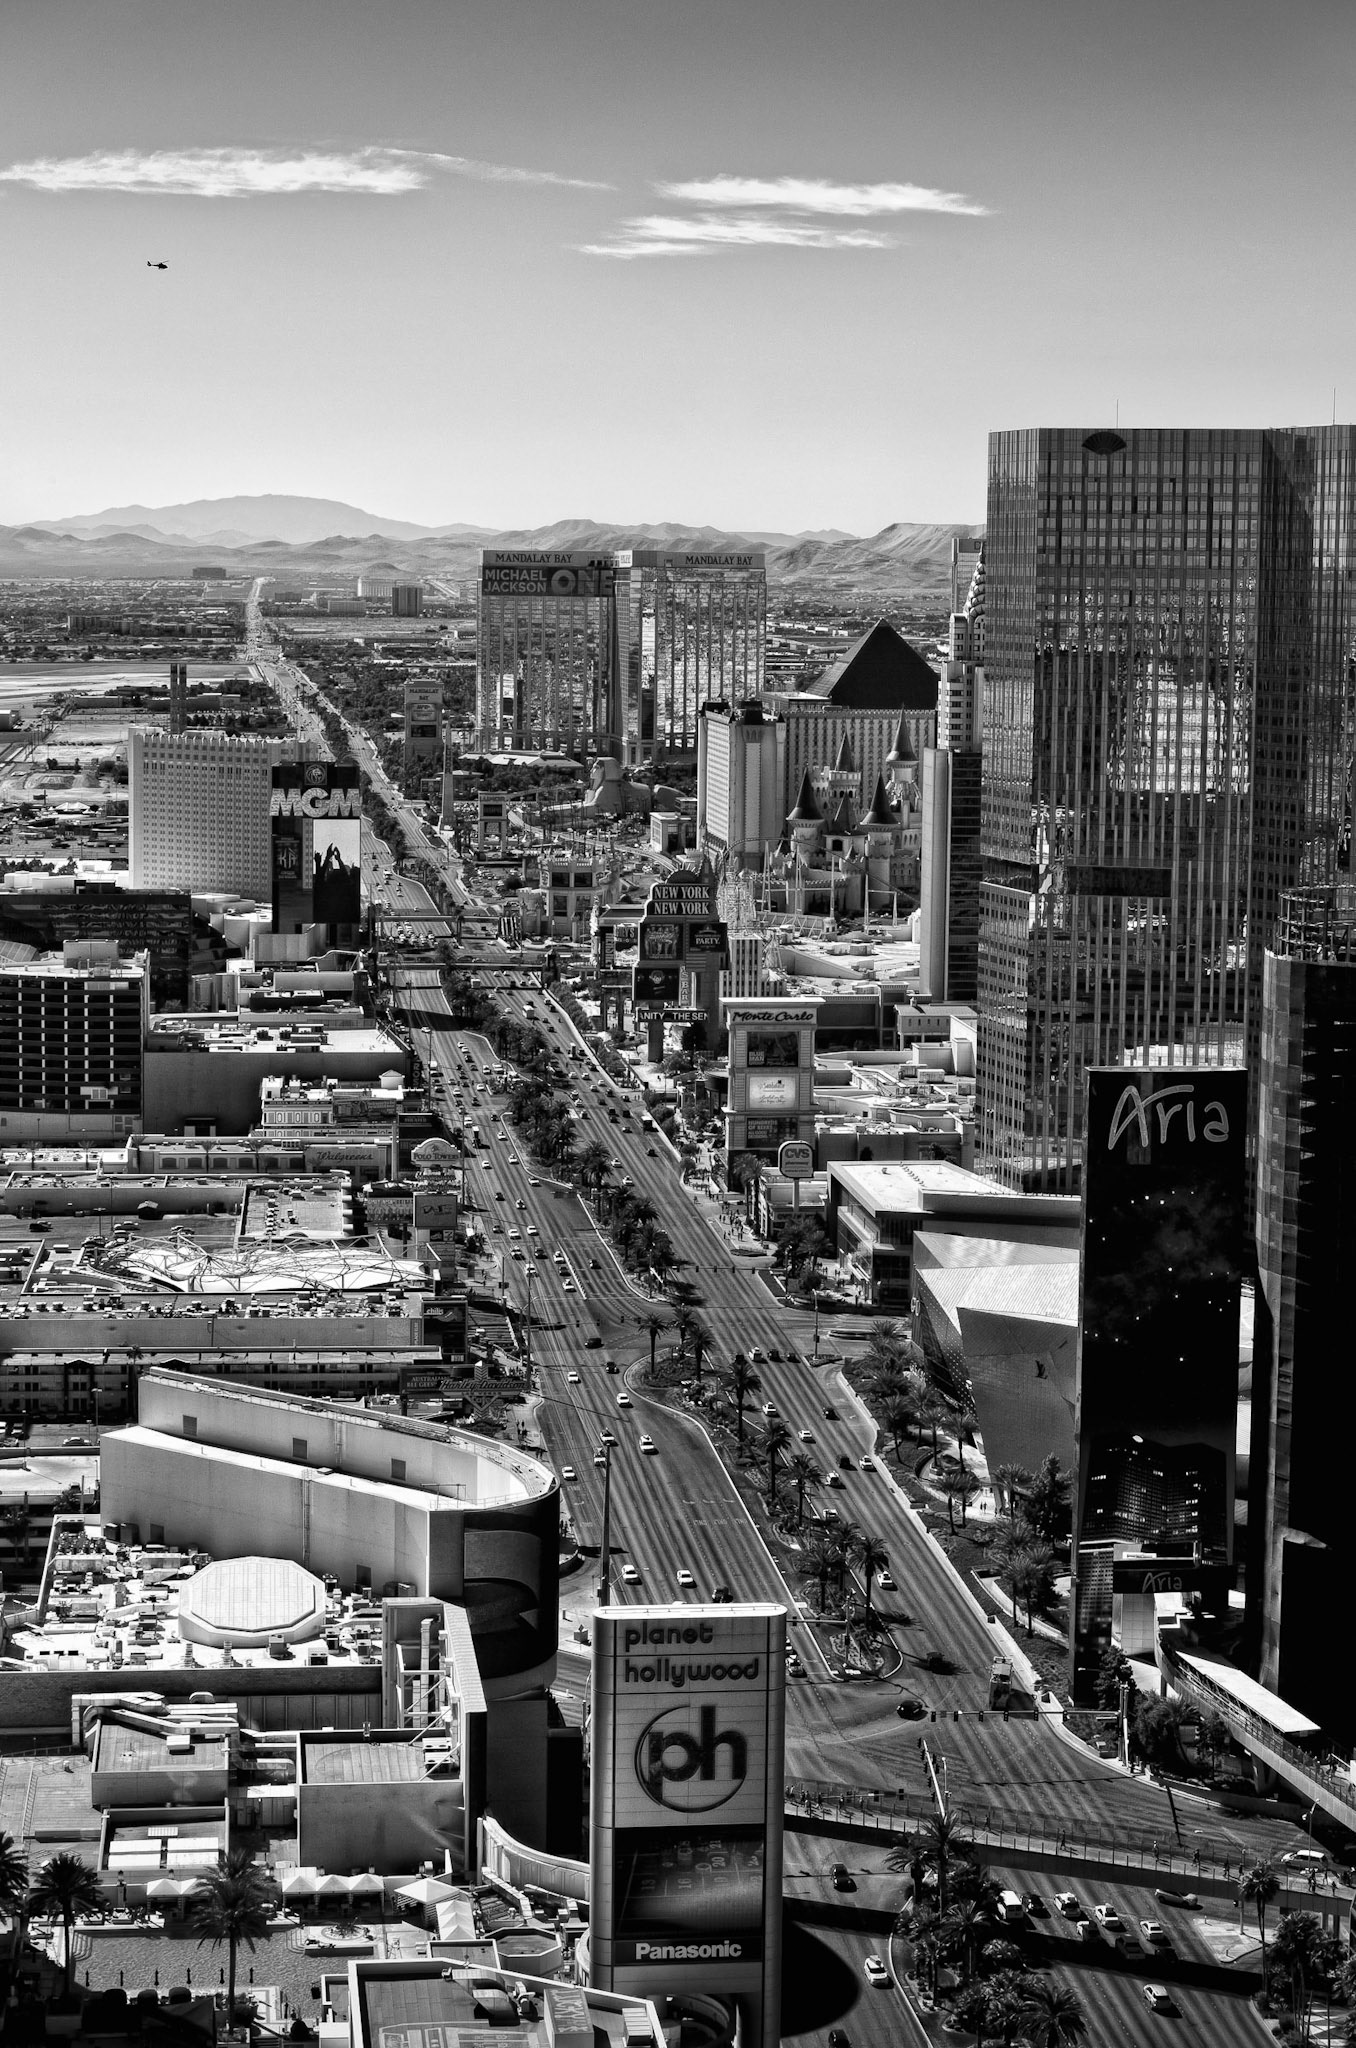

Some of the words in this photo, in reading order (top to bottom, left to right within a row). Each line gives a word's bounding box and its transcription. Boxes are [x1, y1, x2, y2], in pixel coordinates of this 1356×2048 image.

[496, 553, 550, 563] MANDALAY
[554, 554, 573, 563] BAY
[685, 556, 734, 565] MANDALAY
[736, 556, 753, 565] BAY
[485, 569, 547, 580] MICHAEL
[484, 582, 547, 593] JACKSON
[551, 569, 614, 595] ONE
[269, 787, 362, 818] MGM
[654, 886, 679, 899] NEW
[681, 886, 710, 899] YORK
[654, 902, 679, 915] NEW
[681, 902, 710, 915] YORK
[672, 1012, 691, 1021] THE
[733, 1011, 774, 1022] Monte
[774, 1011, 814, 1022] Carlo
[1108, 1084, 1229, 1150] Aria
[317, 1151, 374, 1162] Walgreens
[785, 1148, 810, 1158] CVS
[1141, 1571, 1183, 1593] Aria
[625, 1621, 714, 1652] planet
[625, 1658, 759, 1688] hollywood
[635, 1940, 742, 1960] Panasonic
